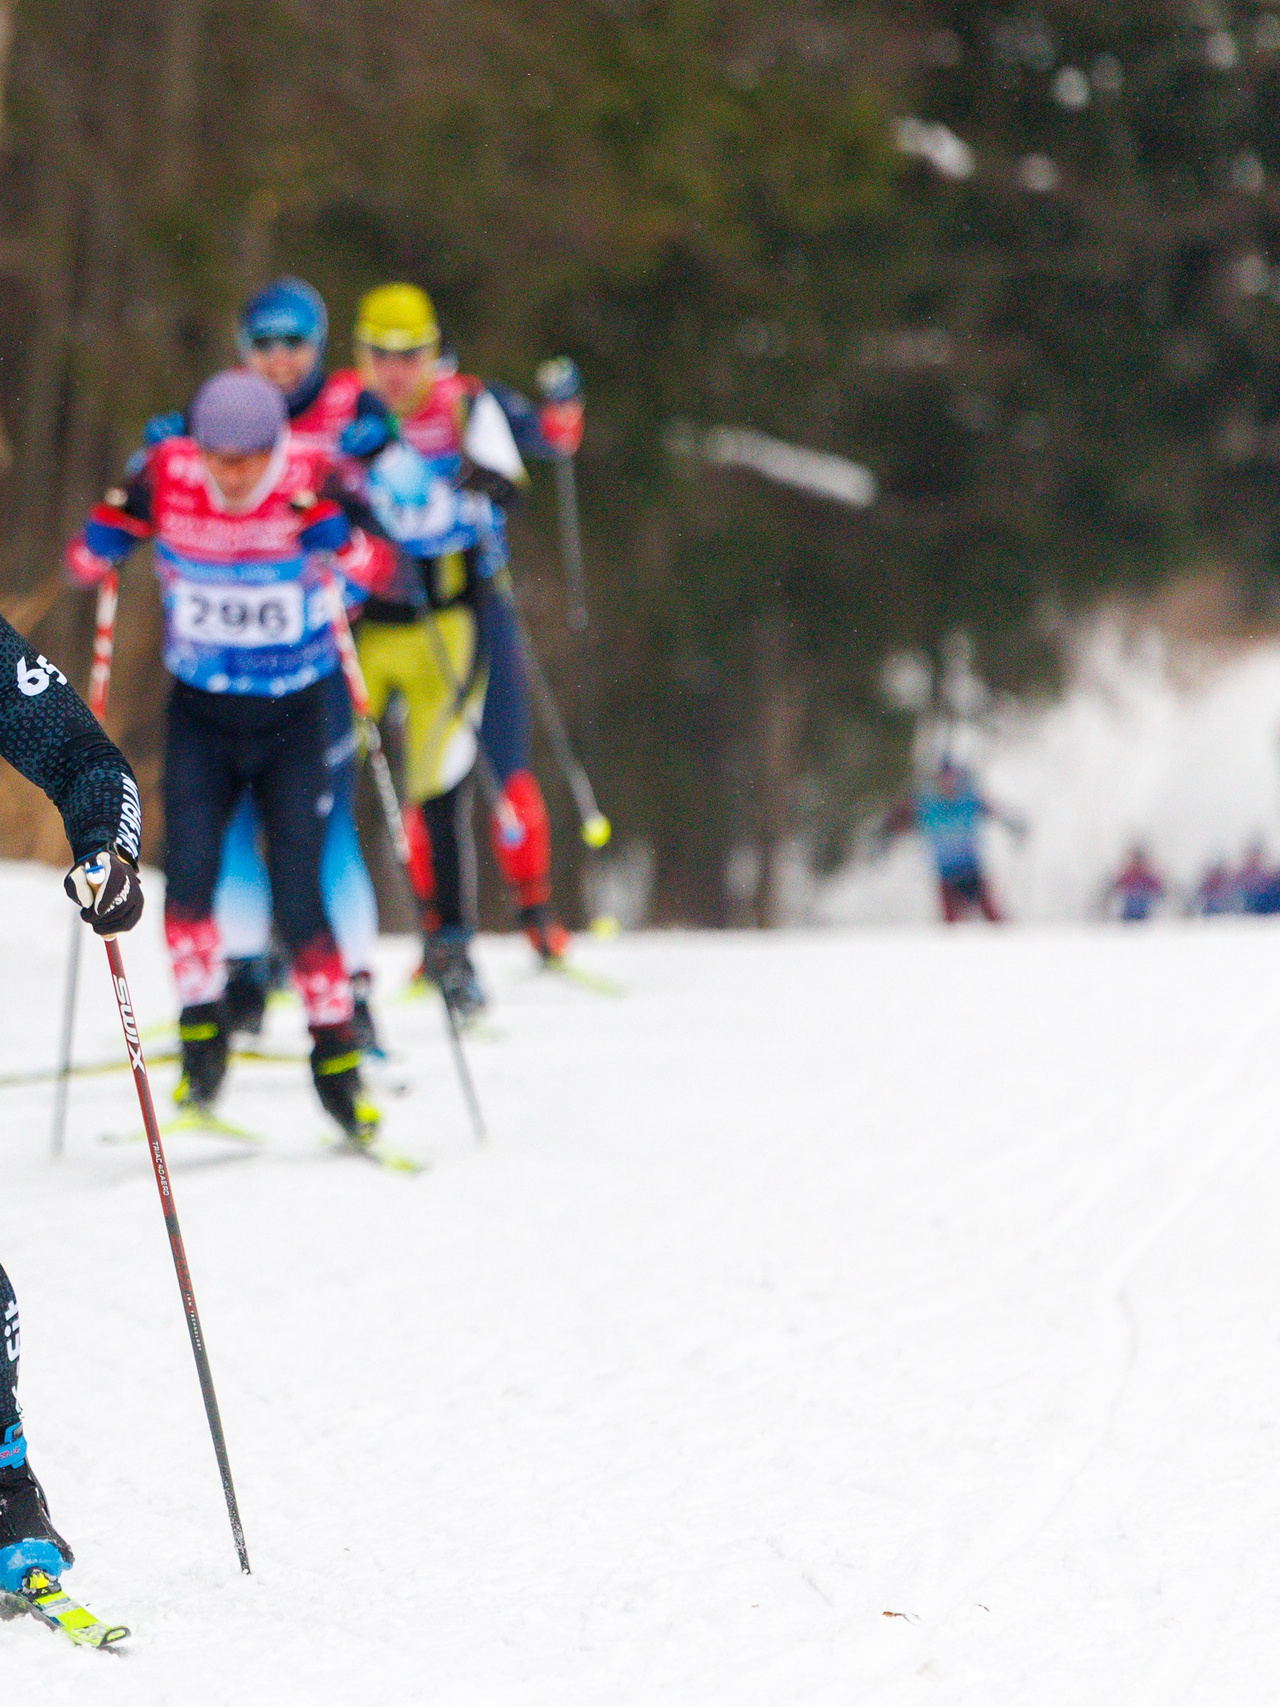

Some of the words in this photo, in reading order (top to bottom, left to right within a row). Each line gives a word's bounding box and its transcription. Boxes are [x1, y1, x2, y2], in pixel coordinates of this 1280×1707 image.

[188, 593, 287, 639] 296
[113, 974, 145, 1076] SWIX
[160, 1175, 170, 1196] AERO
